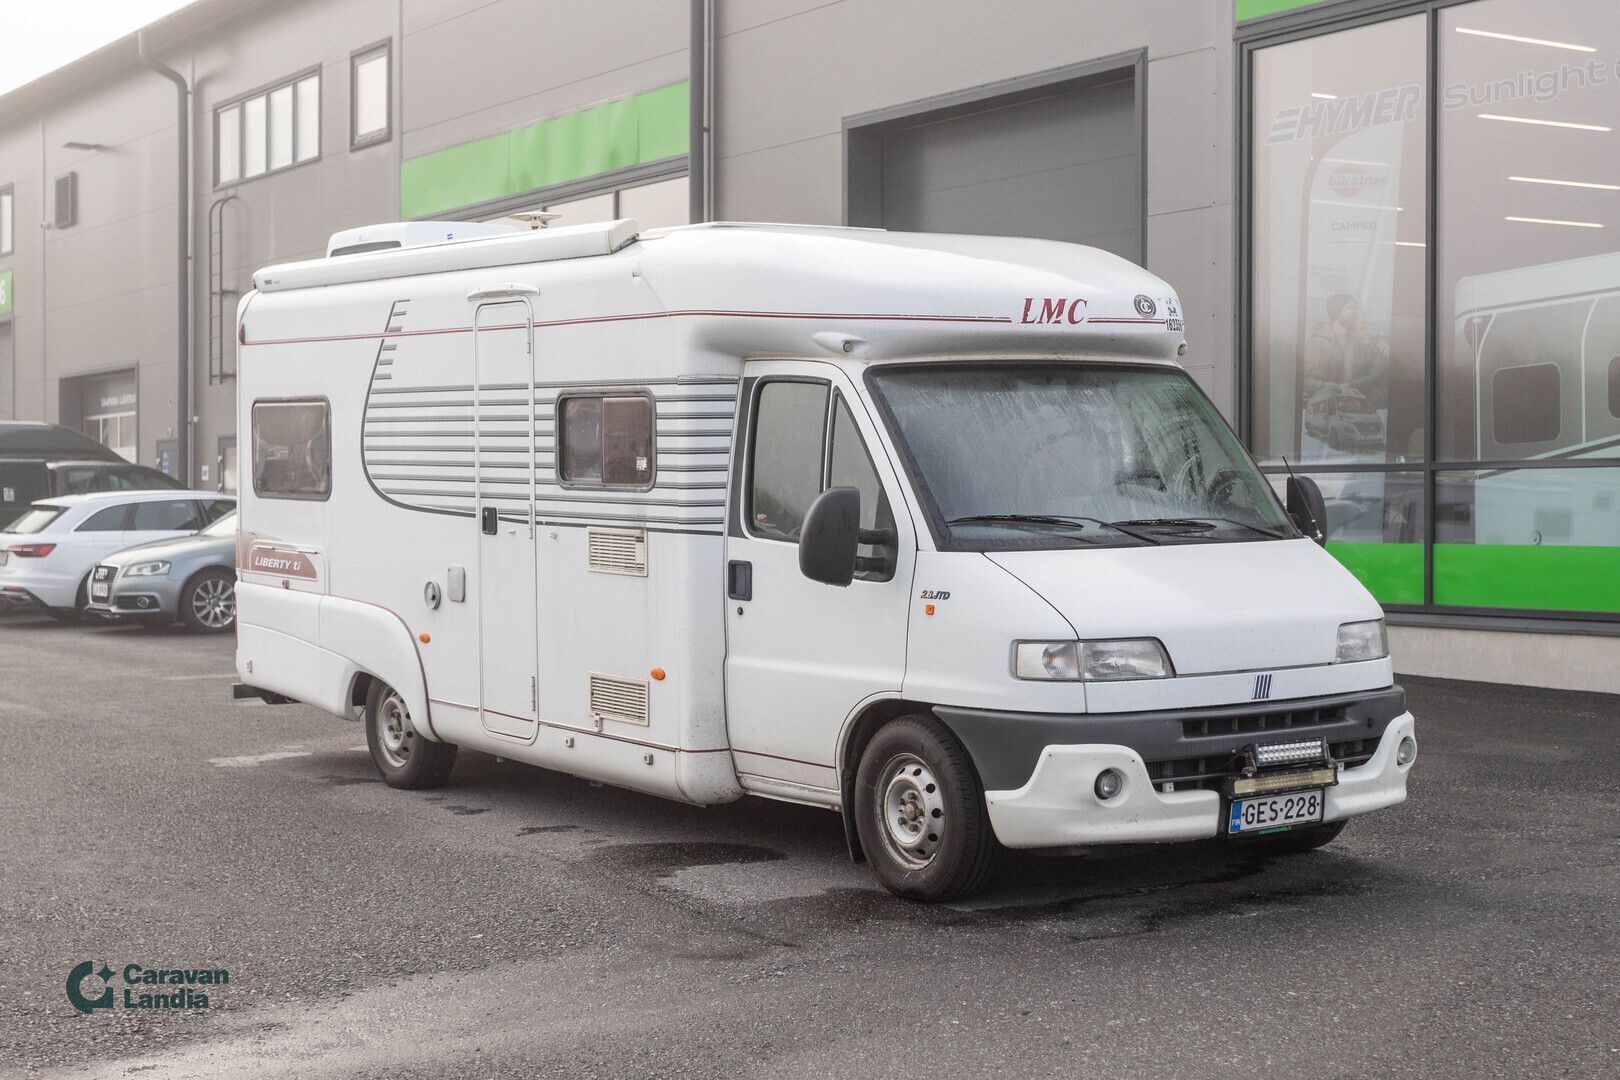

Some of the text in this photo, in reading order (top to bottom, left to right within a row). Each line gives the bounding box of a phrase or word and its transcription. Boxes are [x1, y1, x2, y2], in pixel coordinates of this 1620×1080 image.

[1296, 84, 1422, 139] HYMER
[1021, 297, 1088, 325] LMC
[255, 556, 291, 570] LIBERTY
[1245, 795, 1317, 825] GES-228
